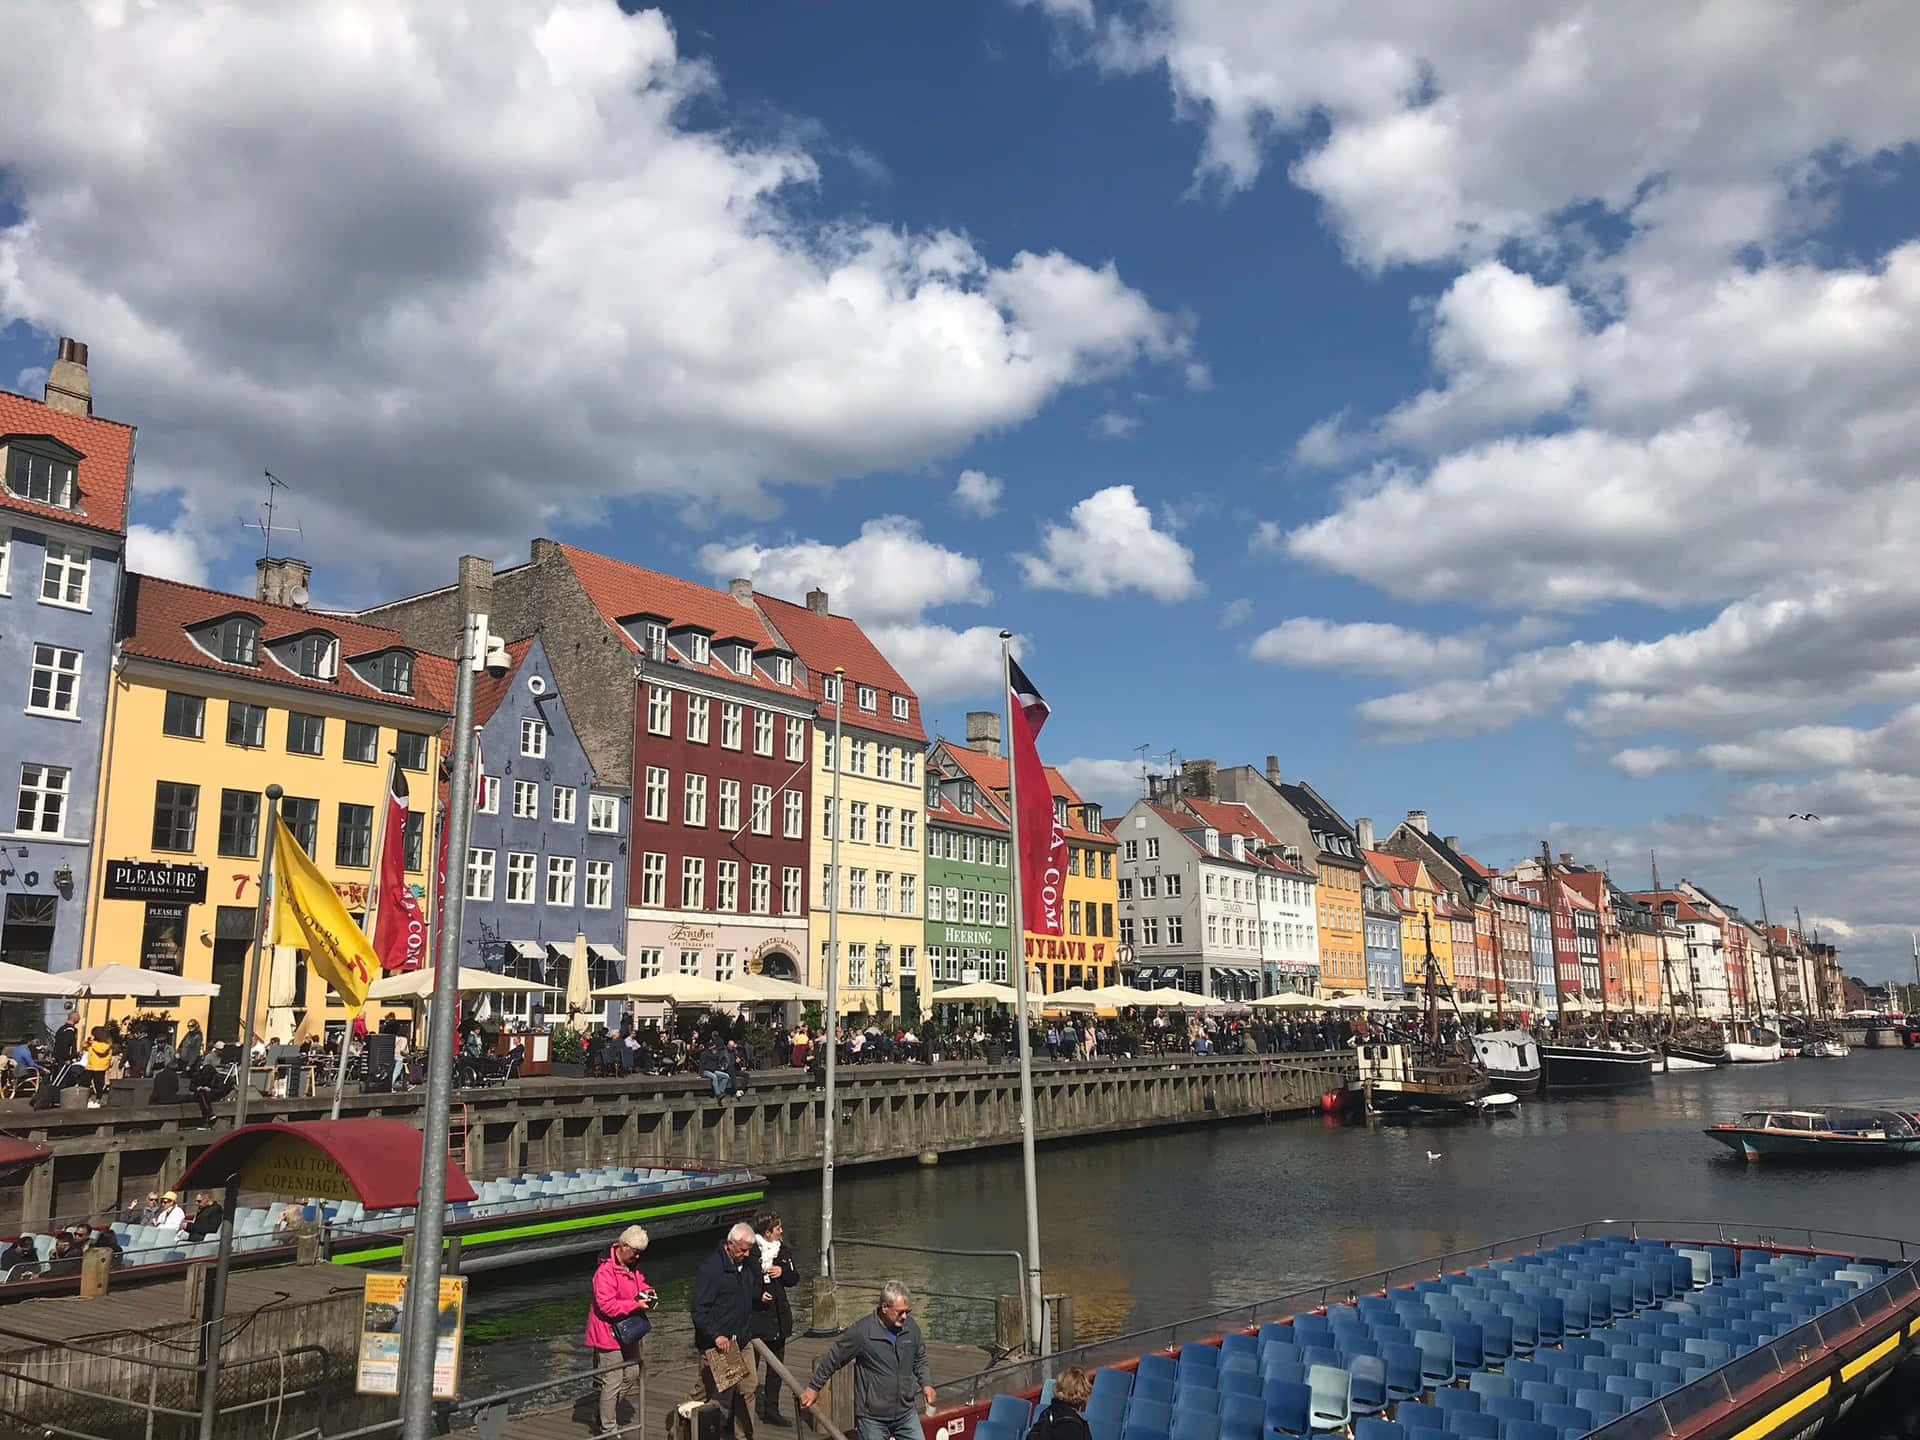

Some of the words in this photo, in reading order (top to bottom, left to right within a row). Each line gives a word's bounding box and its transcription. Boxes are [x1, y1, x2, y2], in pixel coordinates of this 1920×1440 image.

[115, 867, 197, 888] PLEASURE
[232, 874, 250, 900] 7
[149, 908, 182, 916] PLEASURE
[945, 927, 993, 945] HEERING
[1025, 938, 1086, 961] NYHAVN
[1092, 943, 1105, 962] 17
[263, 1173, 350, 1193] COPENHAGEN
